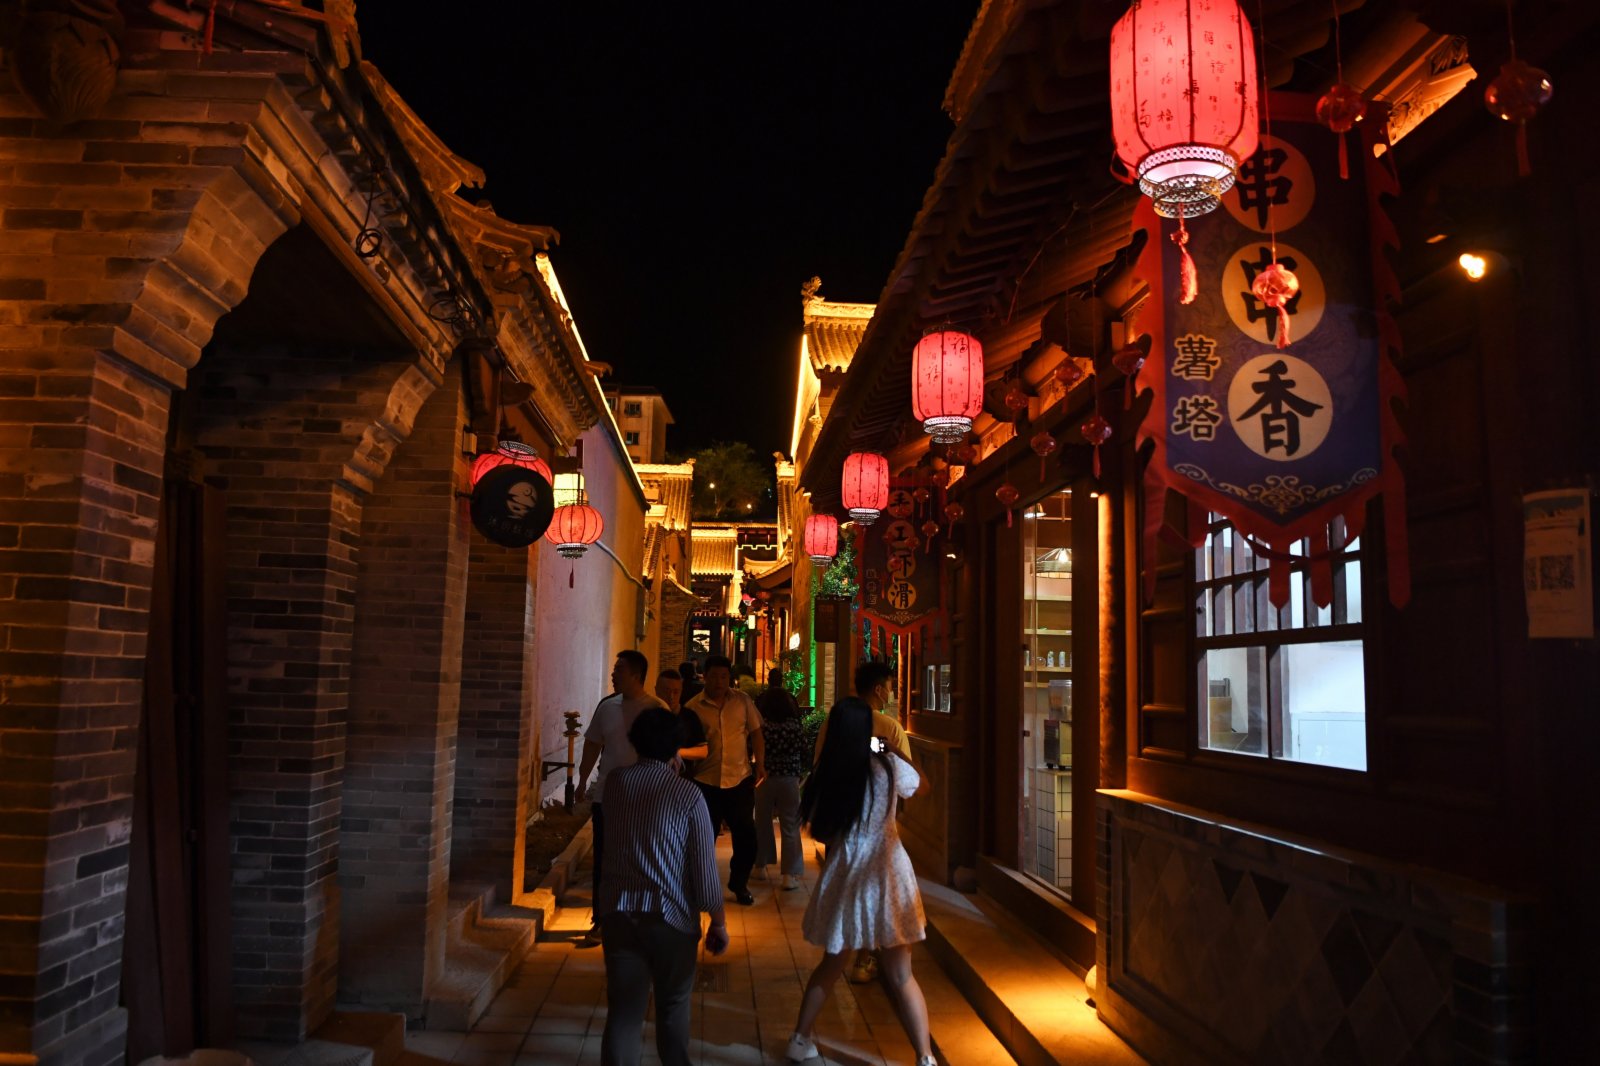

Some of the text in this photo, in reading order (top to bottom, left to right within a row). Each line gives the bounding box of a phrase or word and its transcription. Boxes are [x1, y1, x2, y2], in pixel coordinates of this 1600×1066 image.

[1172, 335, 1221, 441] 薯塔
[1235, 148, 1324, 457] 串串香
